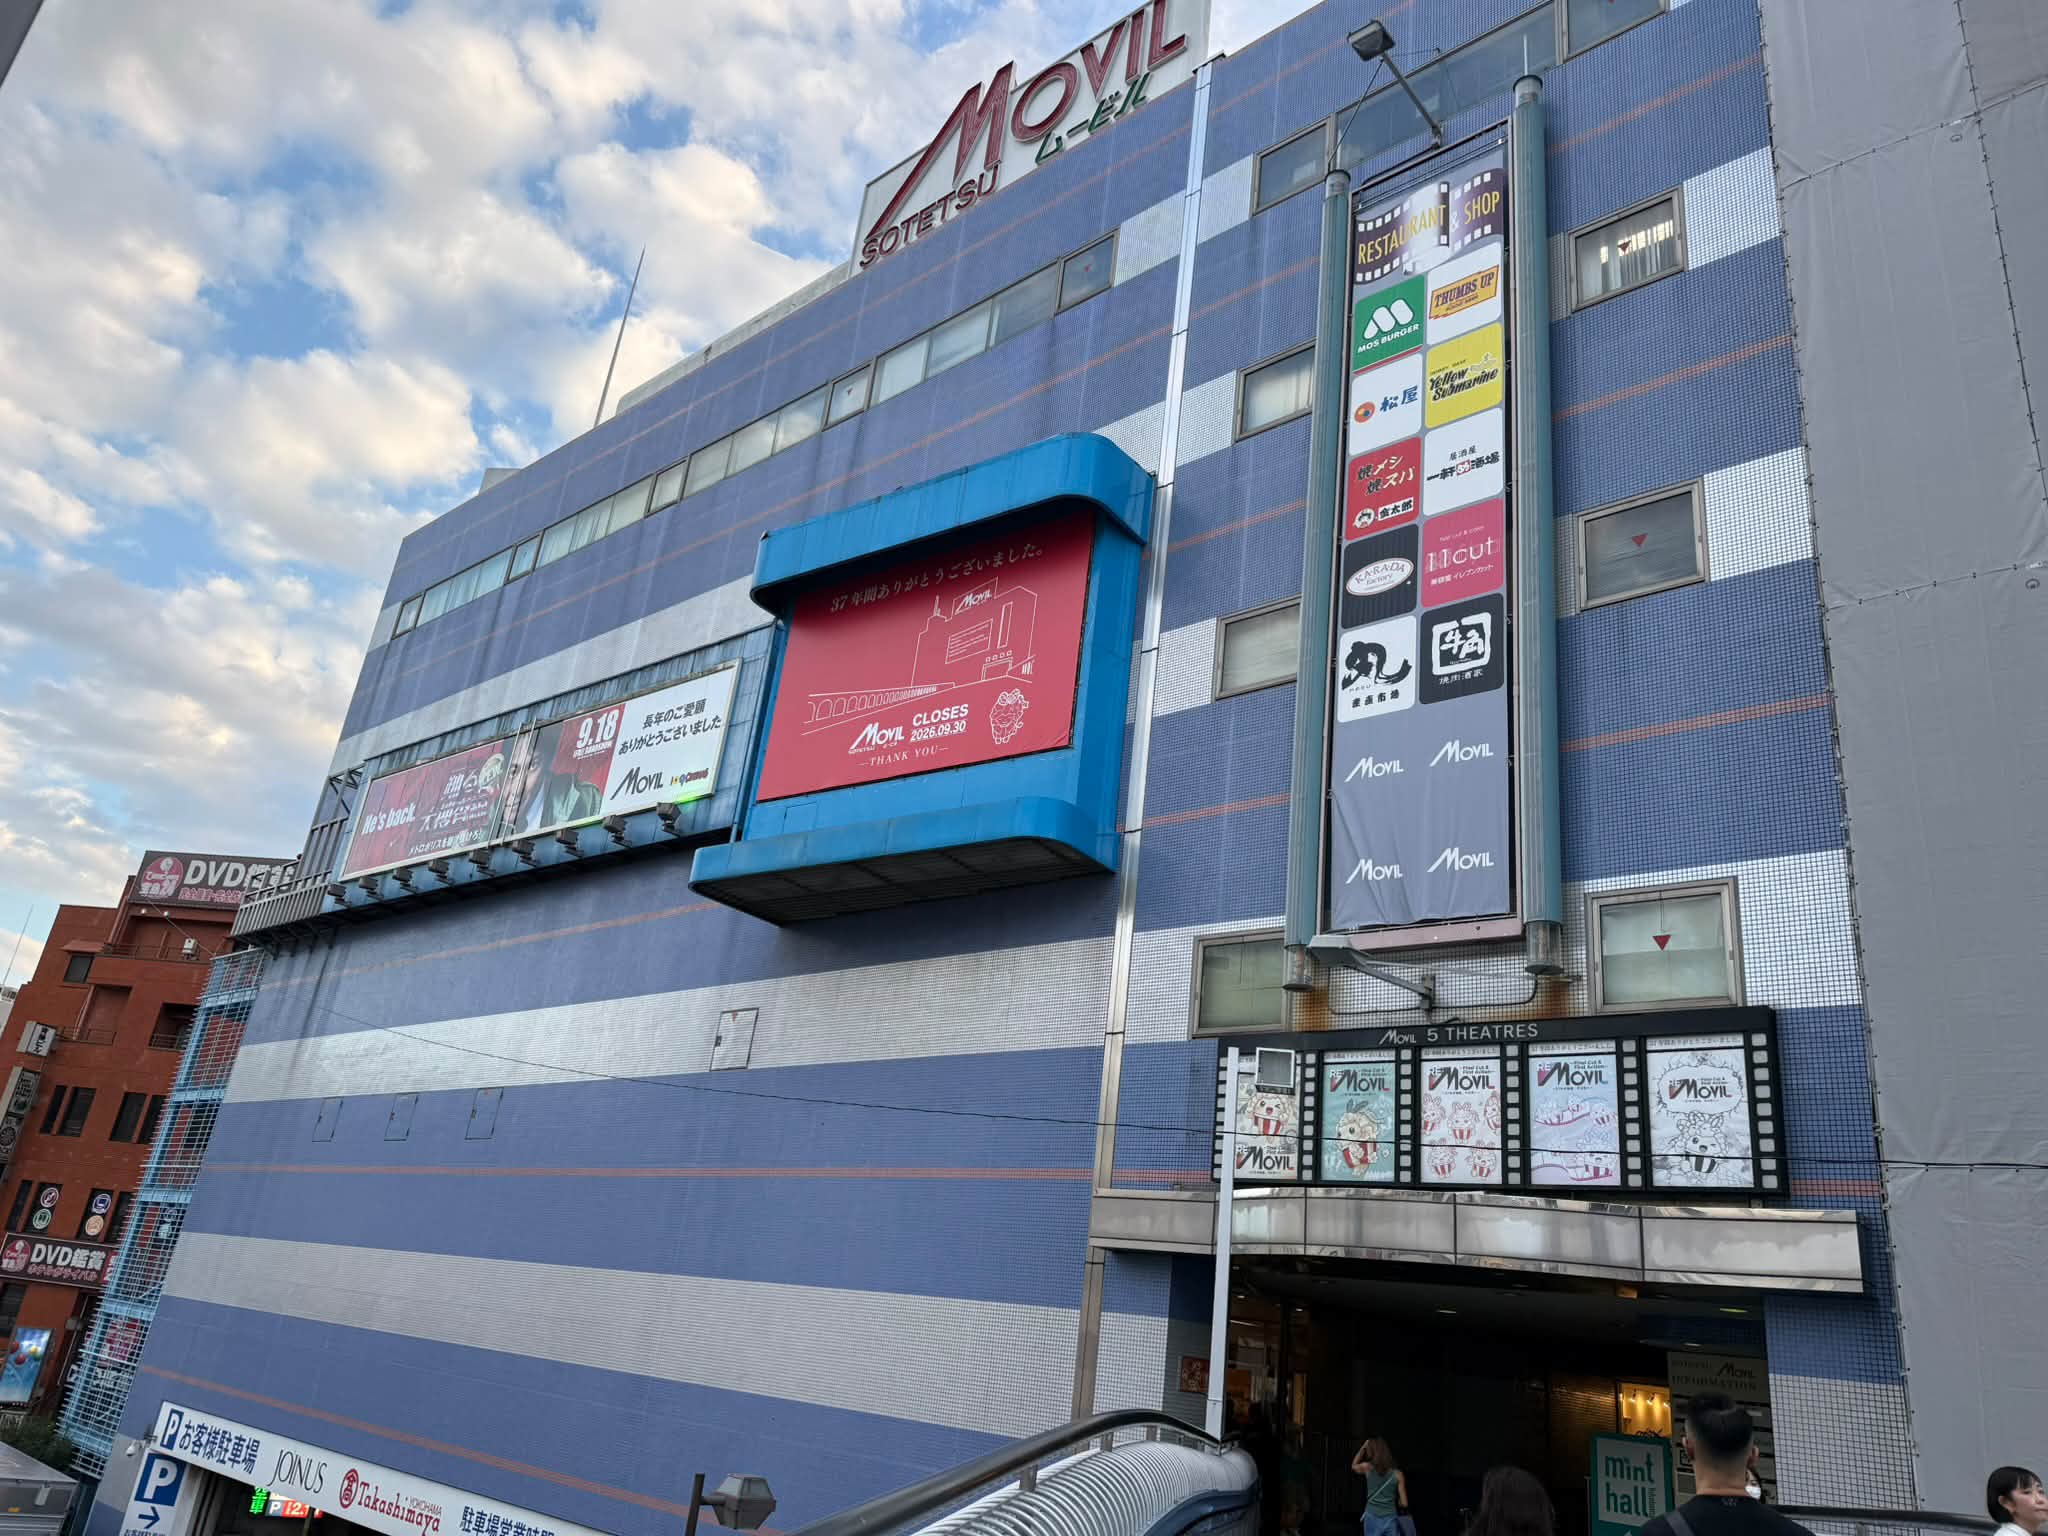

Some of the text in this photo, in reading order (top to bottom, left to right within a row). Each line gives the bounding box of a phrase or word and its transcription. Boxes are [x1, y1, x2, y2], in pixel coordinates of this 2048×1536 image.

[866, 0, 1187, 239] MOVIL
[1034, 72, 1152, 165] ムービル
[859, 164, 1000, 268] SOTETSU
[1358, 191, 1500, 265] RESTAURANT & SHOP
[1434, 278, 1478, 307] THUMBS
[1480, 271, 1495, 289] UP
[1357, 323, 1419, 353] MOS BURGER
[1429, 366, 1469, 392] Yellow
[1432, 368, 1499, 401] Submarine
[1380, 385, 1418, 412] 松屋
[1426, 451, 1500, 481] 一軒め酒場
[1450, 445, 1477, 461] 居酒屋
[1358, 455, 1403, 480] 焼メシ
[1379, 500, 1413, 519] 金太郎
[954, 589, 993, 615] MOVIL
[1440, 628, 1485, 659] 牛角
[642, 697, 707, 730] 長年のご愛顧
[911, 704, 969, 727] CLOSES
[576, 709, 619, 749] 9.18
[618, 715, 721, 755] ありがとうございました
[850, 722, 904, 750] MOVIL
[910, 719, 967, 742] 2026.09.30
[1429, 739, 1494, 767] MOVIL
[610, 766, 664, 801] MOVIL
[1344, 756, 1404, 783] MOVIL
[361, 811, 385, 836] He's
[1345, 858, 1403, 884] MOVIL
[1427, 847, 1495, 873] MOVIL
[1378, 1023, 1539, 1045] MOVIL 5 THEATRES
[1330, 1068, 1390, 1092] MOVIL
[1429, 1066, 1495, 1092] MOVIL
[1538, 1061, 1608, 1087] MOVIL
[1669, 1078, 1732, 1100] MOVIL
[1235, 1145, 1295, 1171] MOVIL
[30, 1243, 107, 1271] DVD鑑賞
[179, 1420, 261, 1475] お客様駐車場
[267, 1449, 328, 1494] JOINUS
[1605, 1451, 1655, 1484] mint
[358, 1480, 441, 1536] Takashimaya
[409, 1495, 442, 1517] YOKOHAMA
[1605, 1482, 1650, 1517] hall
